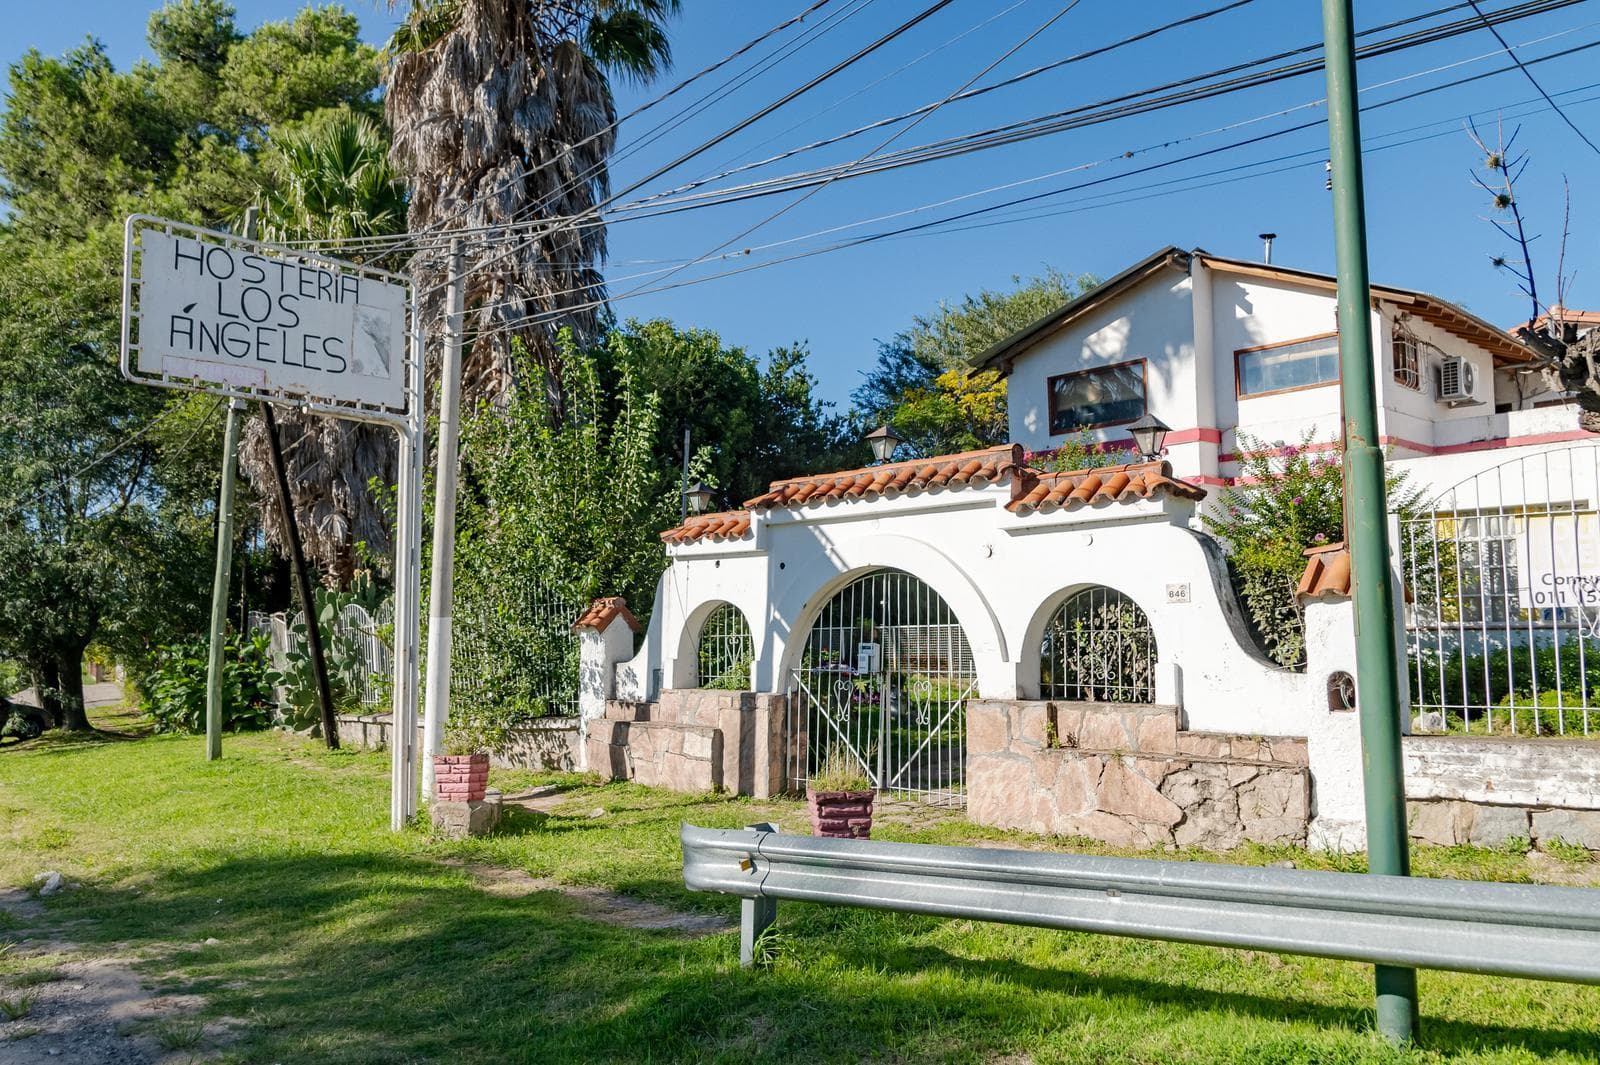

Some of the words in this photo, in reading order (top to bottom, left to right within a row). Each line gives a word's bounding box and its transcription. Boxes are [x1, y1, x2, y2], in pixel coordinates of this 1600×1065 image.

[217, 281, 300, 329] LOS
[170, 302, 347, 374] ÁNGELES
[1168, 590, 1186, 598] 846
[1534, 591, 1566, 604] 011
